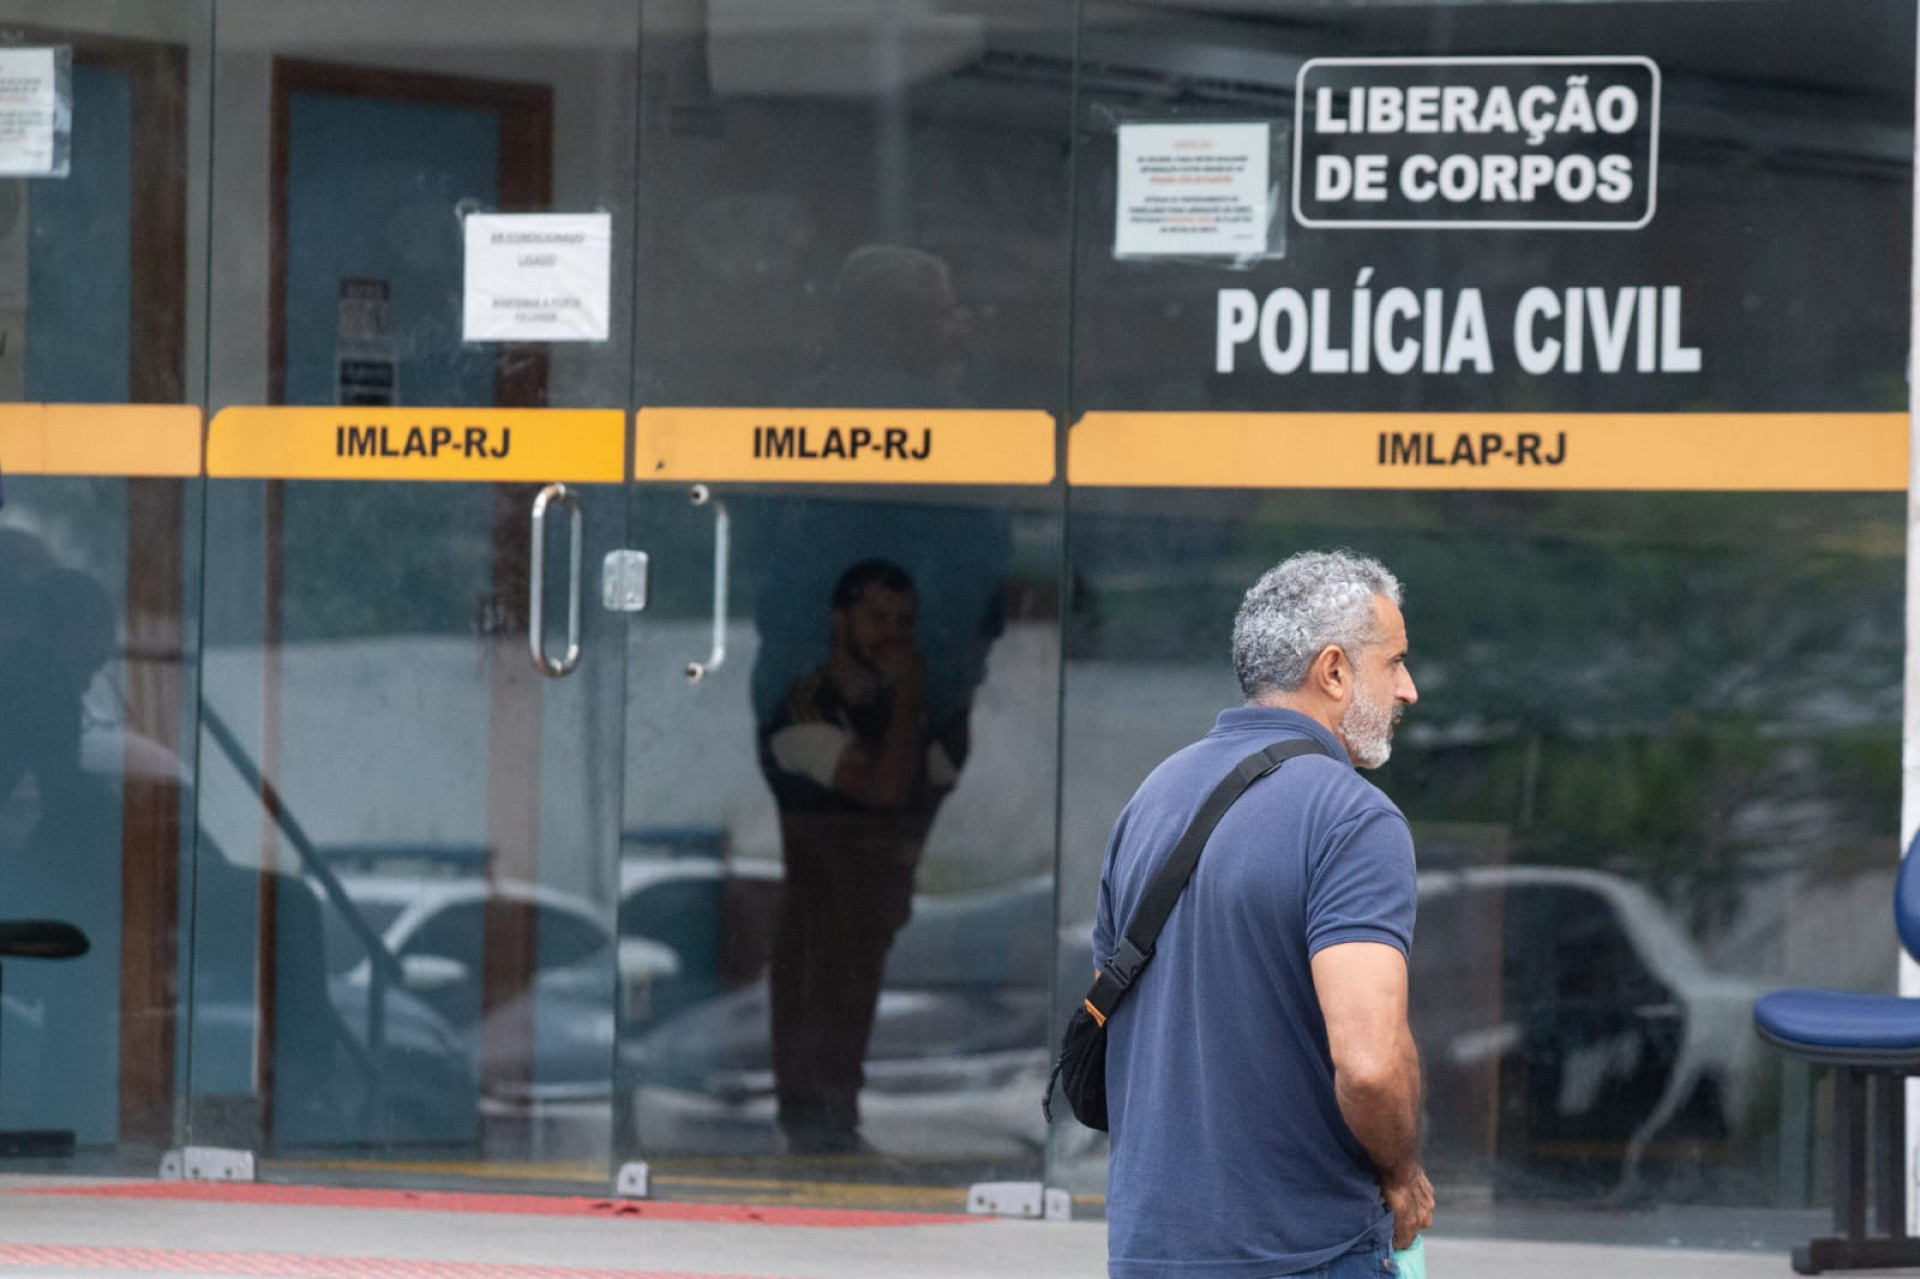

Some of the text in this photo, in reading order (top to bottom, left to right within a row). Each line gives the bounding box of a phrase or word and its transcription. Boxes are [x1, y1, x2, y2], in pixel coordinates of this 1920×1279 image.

[1315, 75, 1639, 145] LIBERAÇÃO
[1315, 153, 1634, 203] DE CORPOS
[1215, 266, 1702, 375] POLÍCIA CIVIL
[336, 426, 510, 459] IMLAP-RJ
[753, 427, 932, 461] IMLAP-RJ
[1378, 431, 1567, 466] IMLAP-RJ
